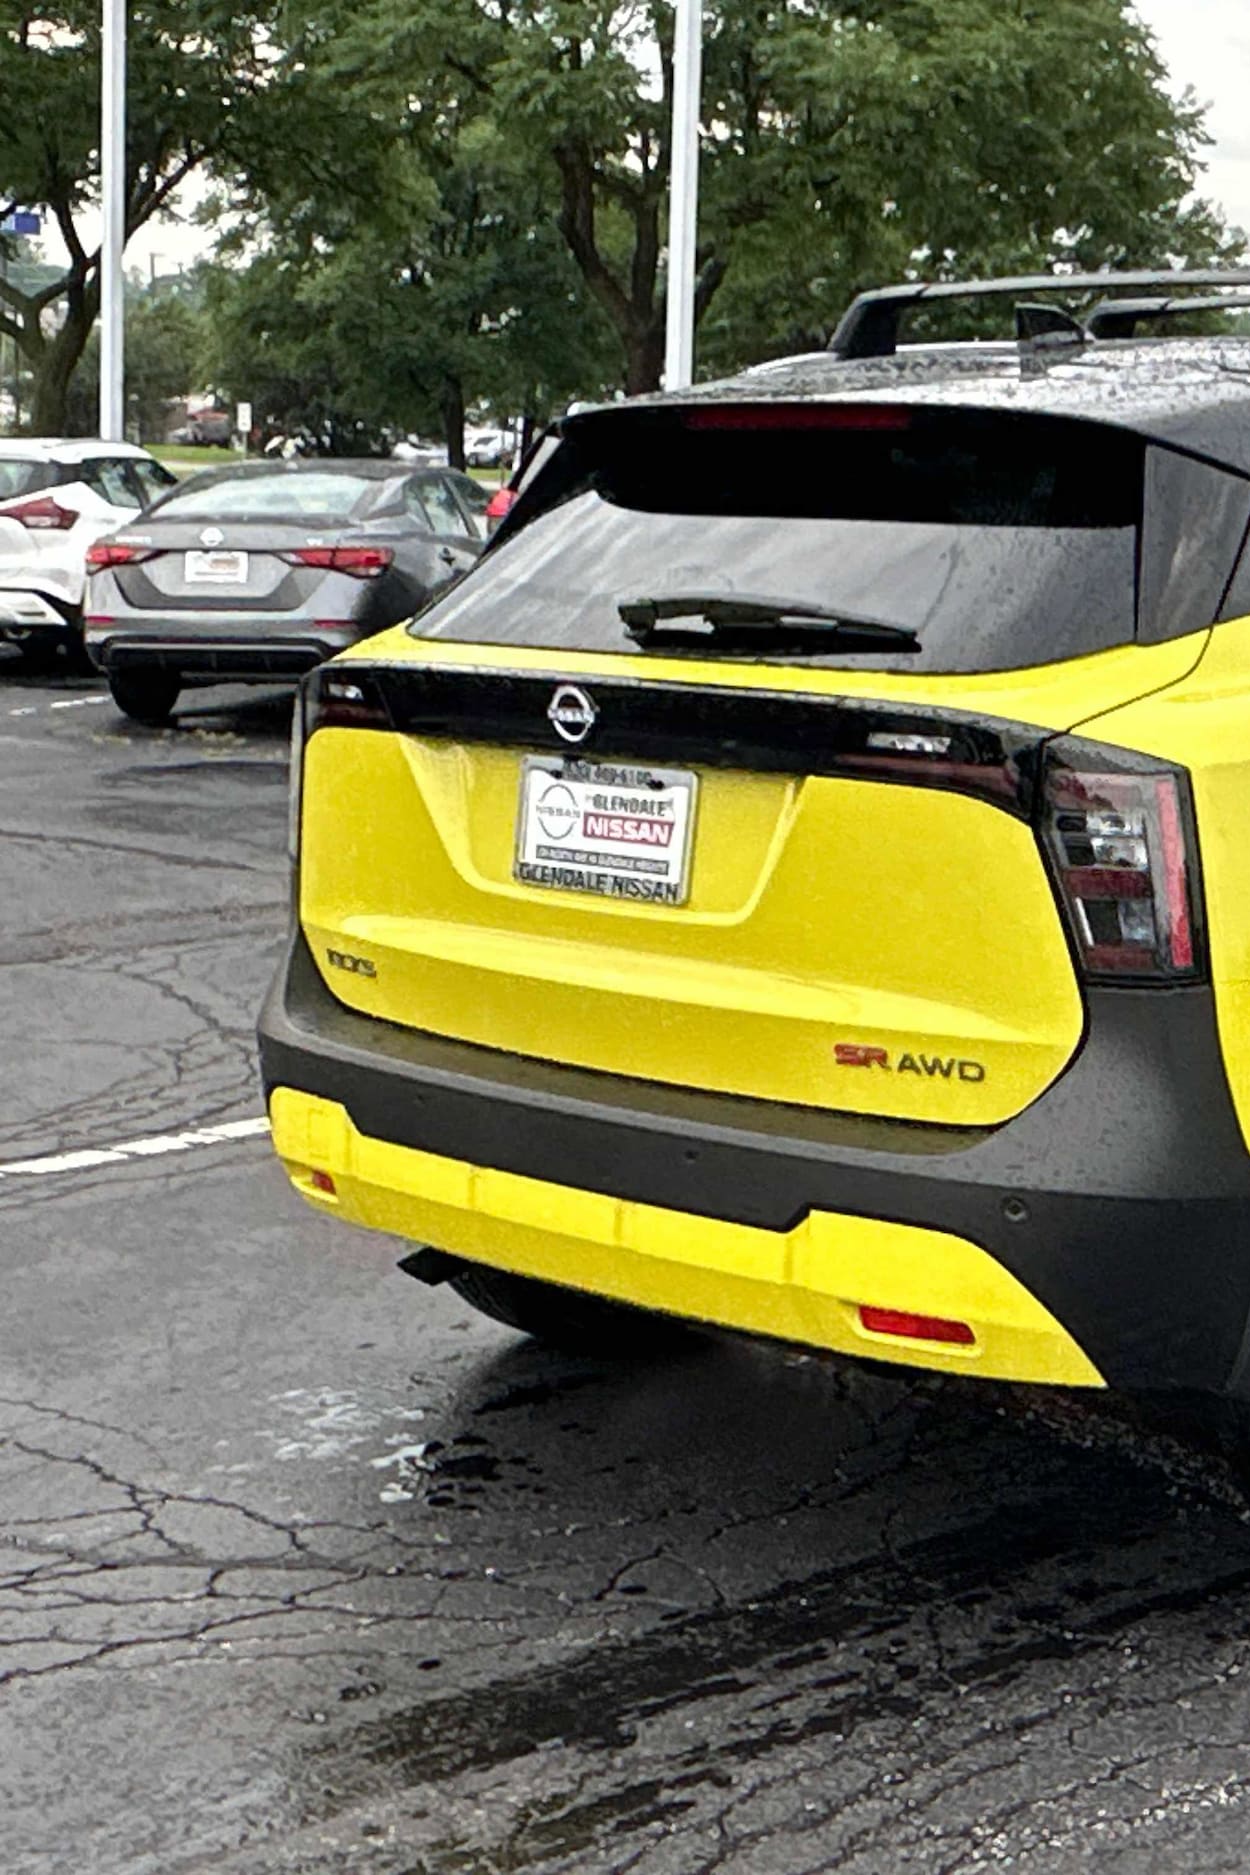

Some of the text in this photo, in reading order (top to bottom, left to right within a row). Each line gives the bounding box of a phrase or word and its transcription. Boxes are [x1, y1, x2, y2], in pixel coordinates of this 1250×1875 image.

[592, 793, 666, 817] GLENDALE
[586, 816, 670, 845] NISSAN
[518, 862, 679, 902] GLENDALE NISSAN
[833, 1044, 985, 1082] SR AWD
